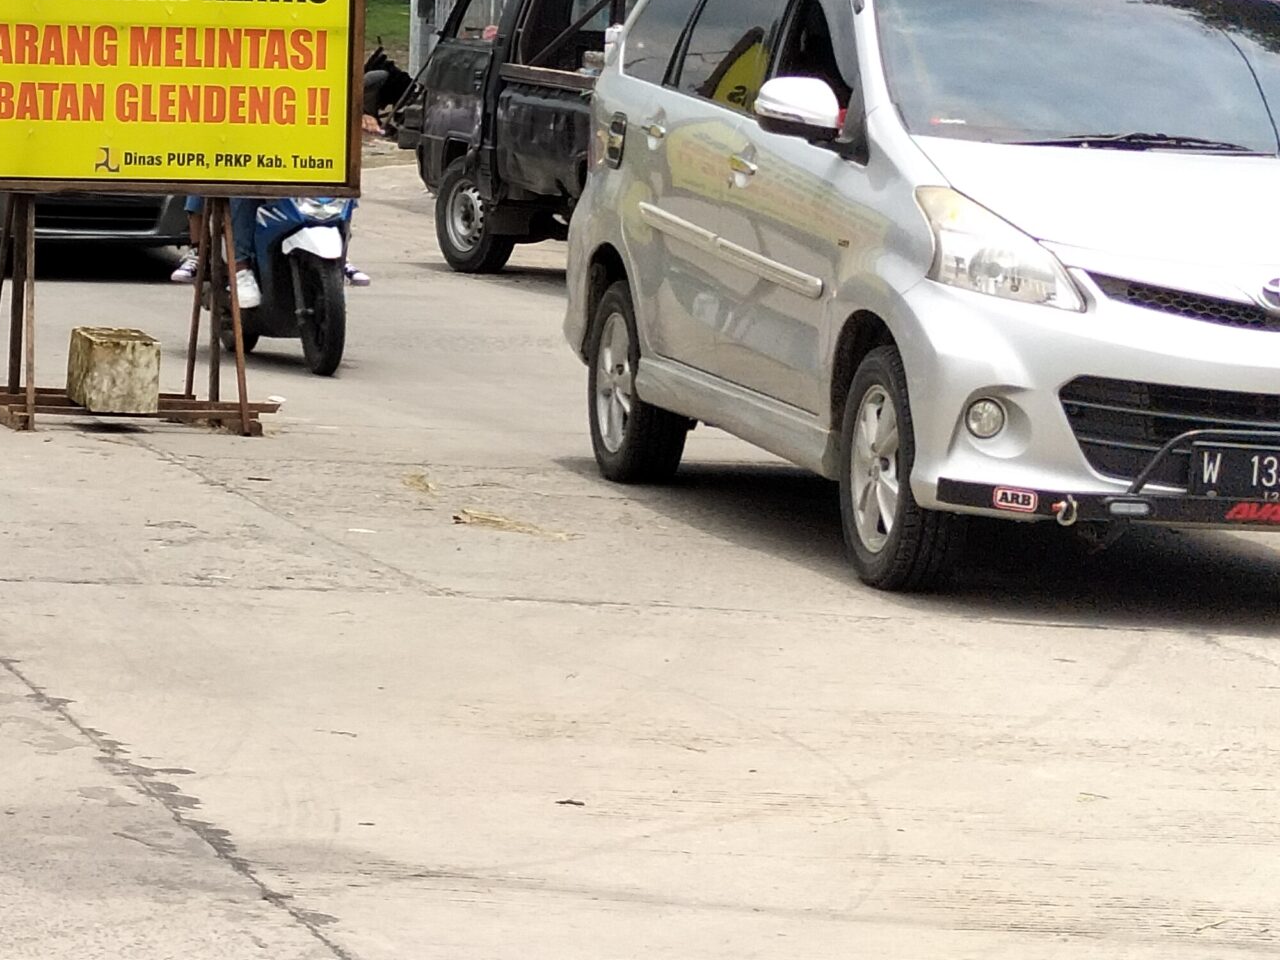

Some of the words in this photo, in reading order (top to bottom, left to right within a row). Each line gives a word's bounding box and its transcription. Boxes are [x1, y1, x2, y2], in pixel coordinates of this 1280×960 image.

[129, 26, 327, 70] MELINTASI
[115, 84, 296, 125] GLENDENG
[307, 88, 329, 125] !!
[124, 152, 162, 167] Dinas
[167, 153, 209, 170] PUPR,
[215, 155, 252, 168] PRKP
[257, 155, 287, 169] Kab.
[292, 155, 333, 169] Tuban
[1203, 451, 1221, 484] W
[1251, 455, 1280, 487] 13
[999, 492, 1031, 506] ARB
